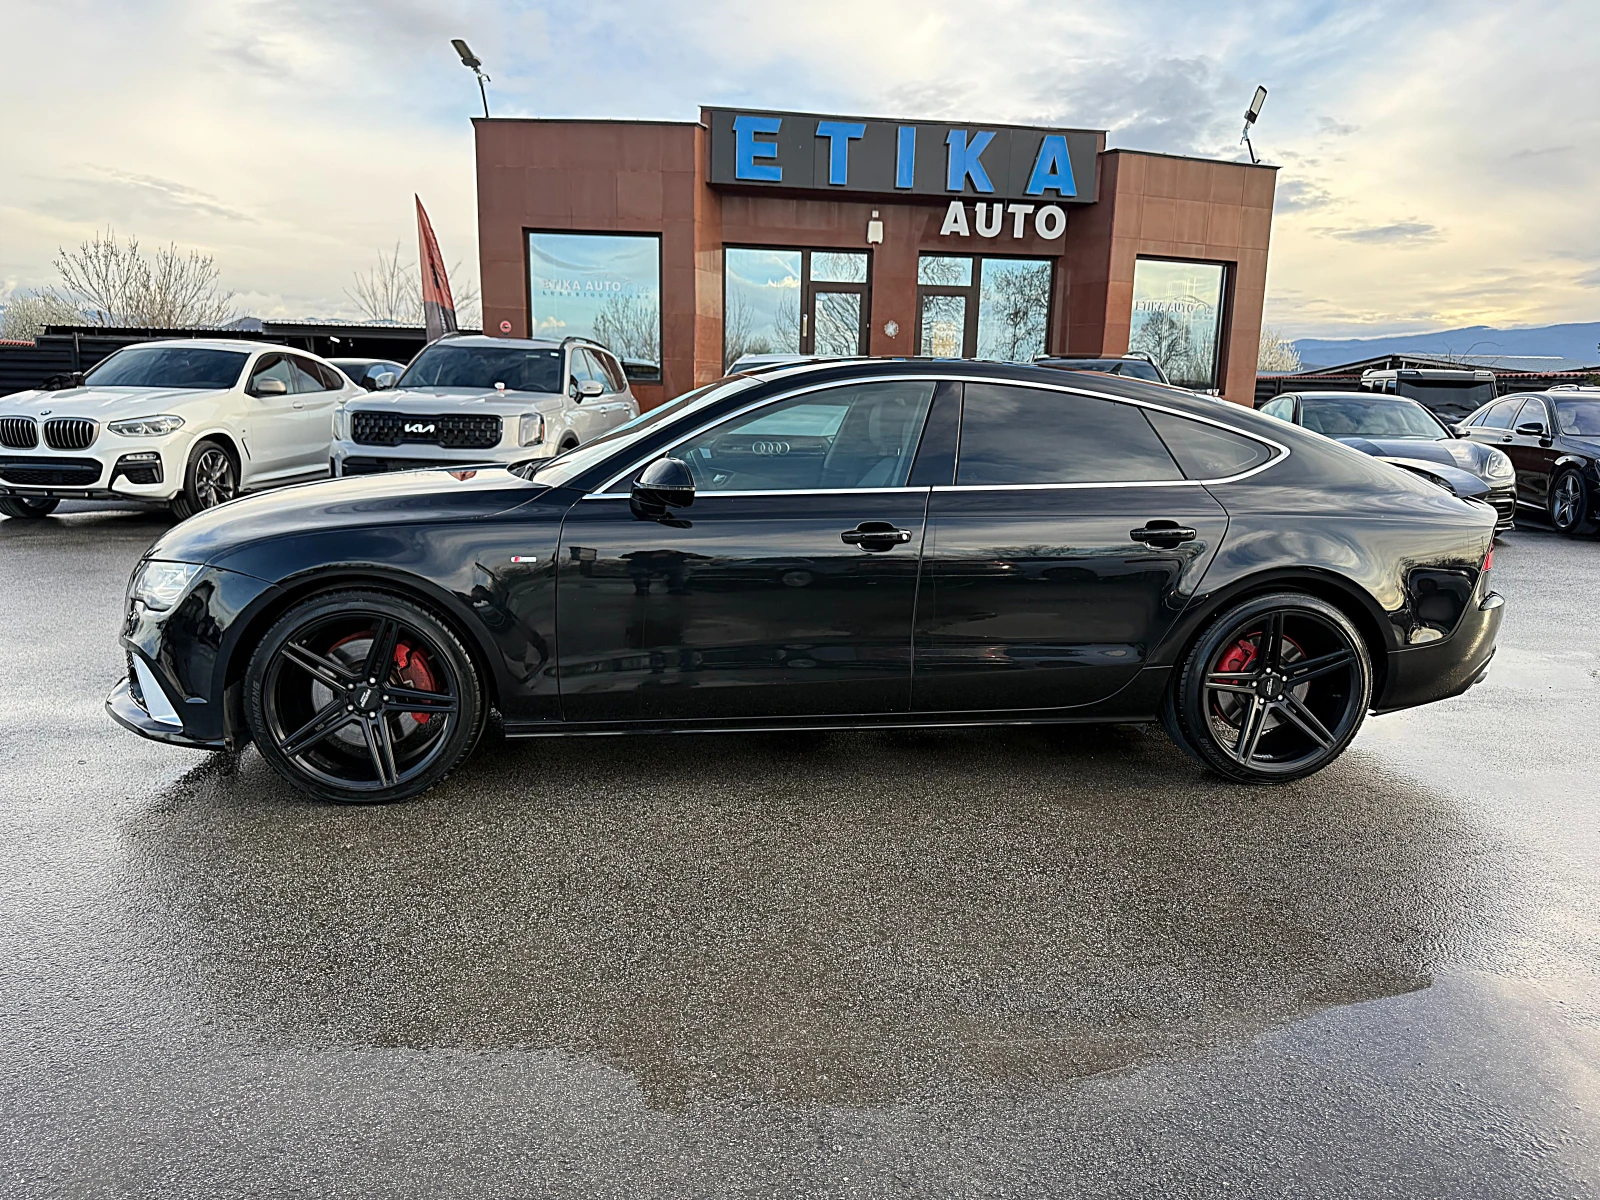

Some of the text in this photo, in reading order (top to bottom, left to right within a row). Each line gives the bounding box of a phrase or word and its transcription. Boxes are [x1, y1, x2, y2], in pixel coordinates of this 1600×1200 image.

[733, 116, 1077, 196] ETIKA
[940, 201, 1066, 239] AUTO
[543, 279, 622, 292] ETIKA AUTO
[404, 423, 435, 433] KIA
[252, 680, 265, 734] NANKANG
